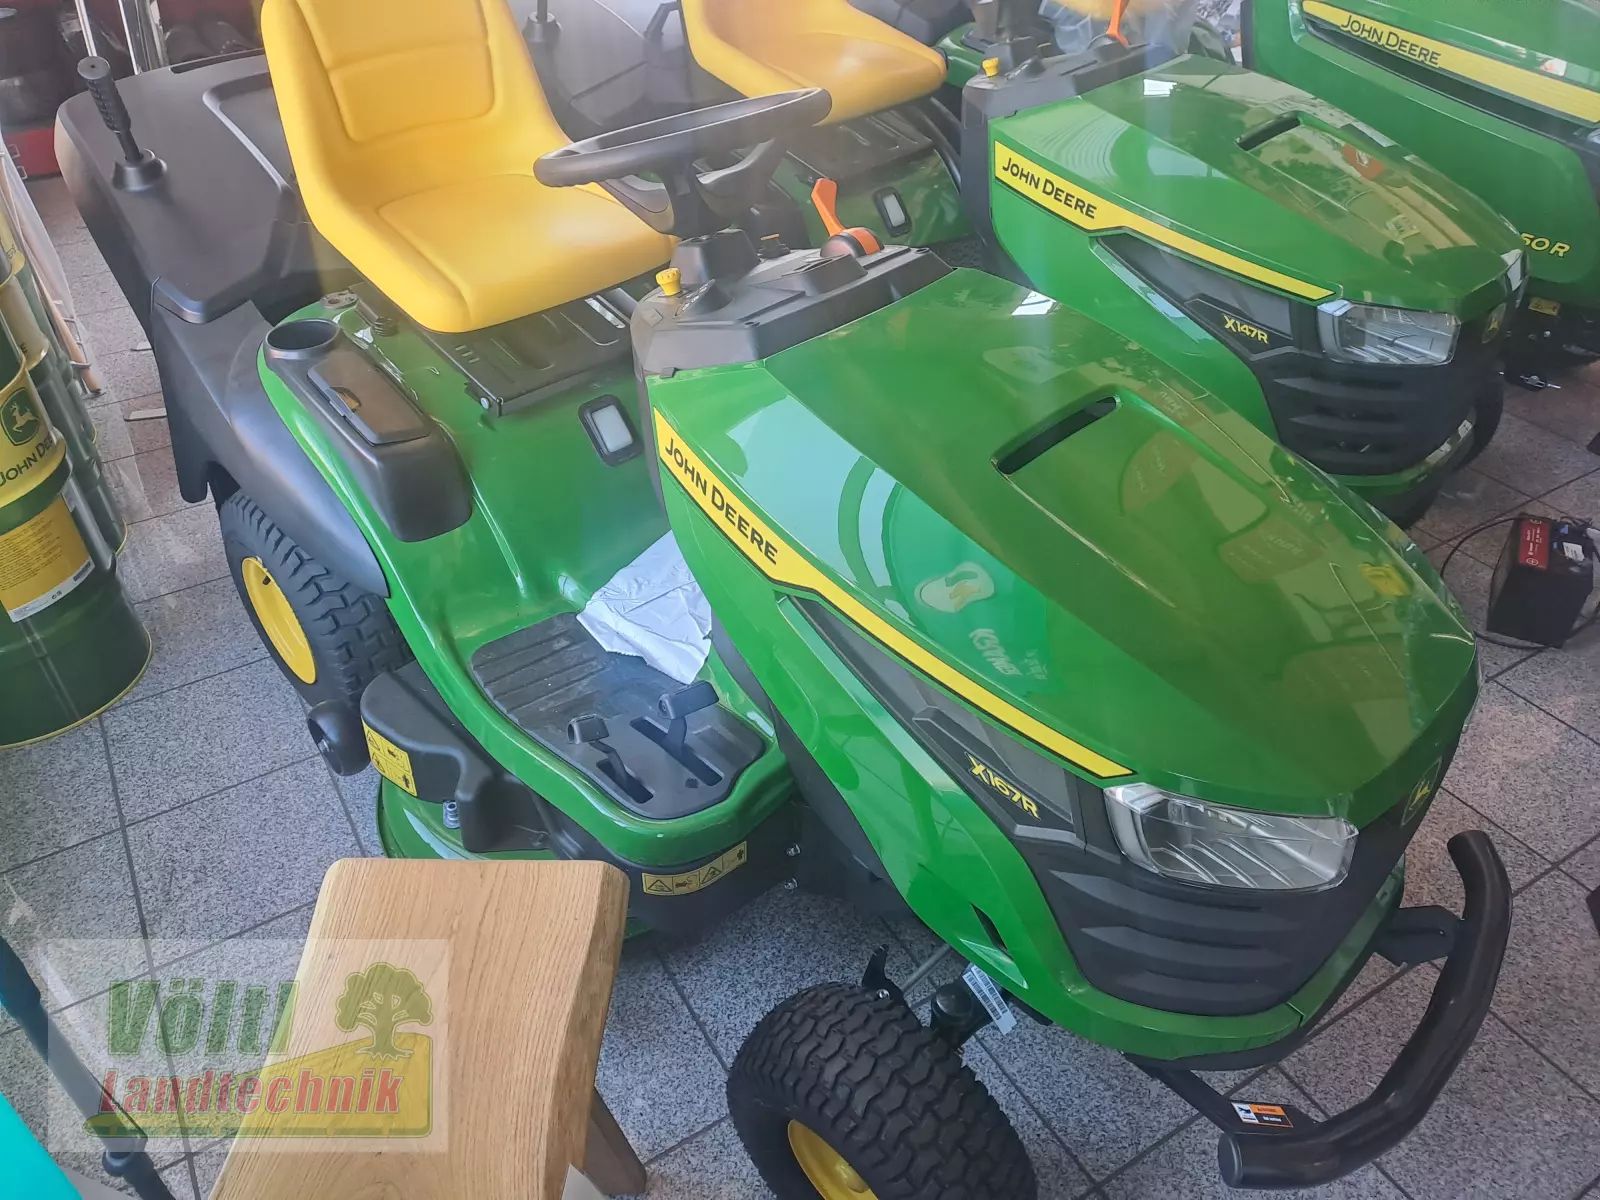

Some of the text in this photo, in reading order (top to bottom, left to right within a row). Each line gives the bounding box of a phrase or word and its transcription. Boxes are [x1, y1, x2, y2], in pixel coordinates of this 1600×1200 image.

[1341, 15, 1441, 65] JOHN DEERE
[1002, 157, 1097, 219] JOHN DEERE
[1223, 314, 1268, 344] X147R
[0, 452, 38, 487] JOHN
[665, 438, 778, 566] JOHN DEERE
[965, 752, 1041, 820] X167R
